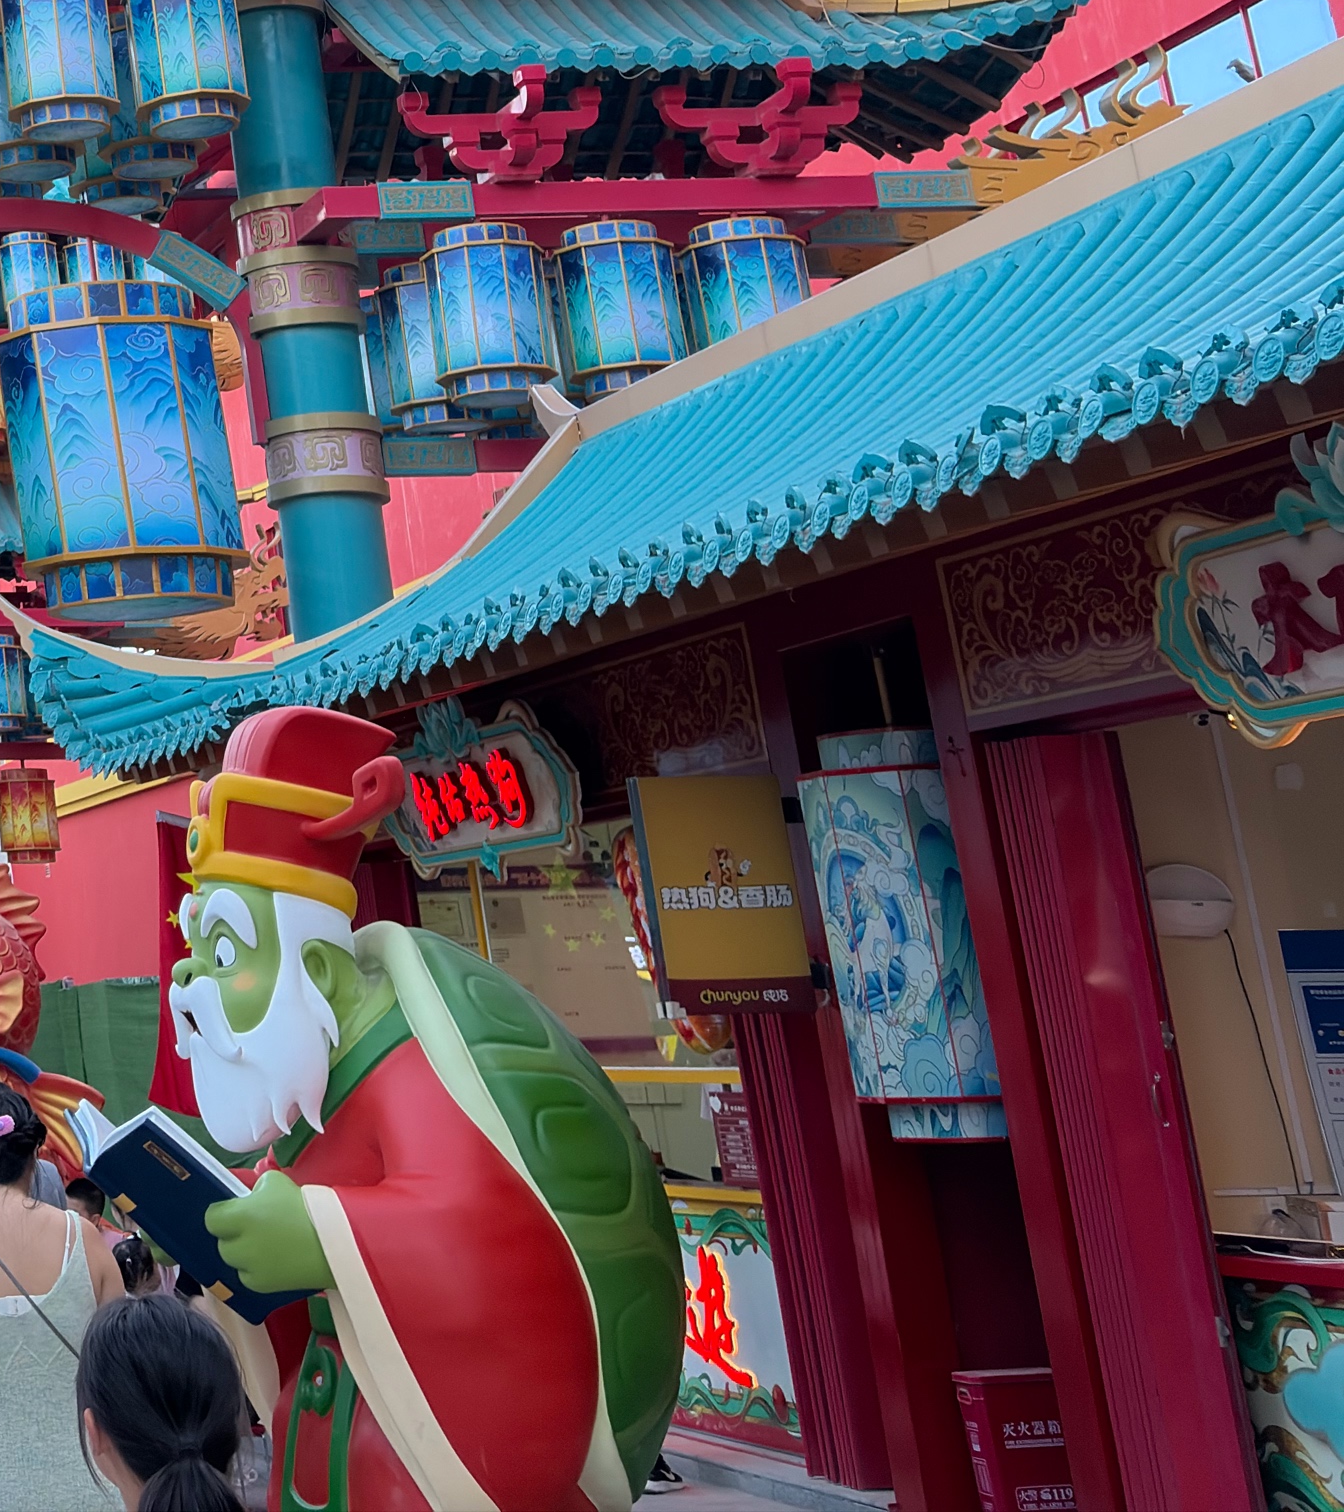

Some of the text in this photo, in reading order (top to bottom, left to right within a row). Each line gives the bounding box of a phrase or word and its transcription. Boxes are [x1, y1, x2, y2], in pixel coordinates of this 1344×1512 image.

[661, 885, 793, 909] 热狗&香肠
[1003, 1419, 1062, 1438] 灭火器箱
[1053, 1487, 1073, 1500] 119
